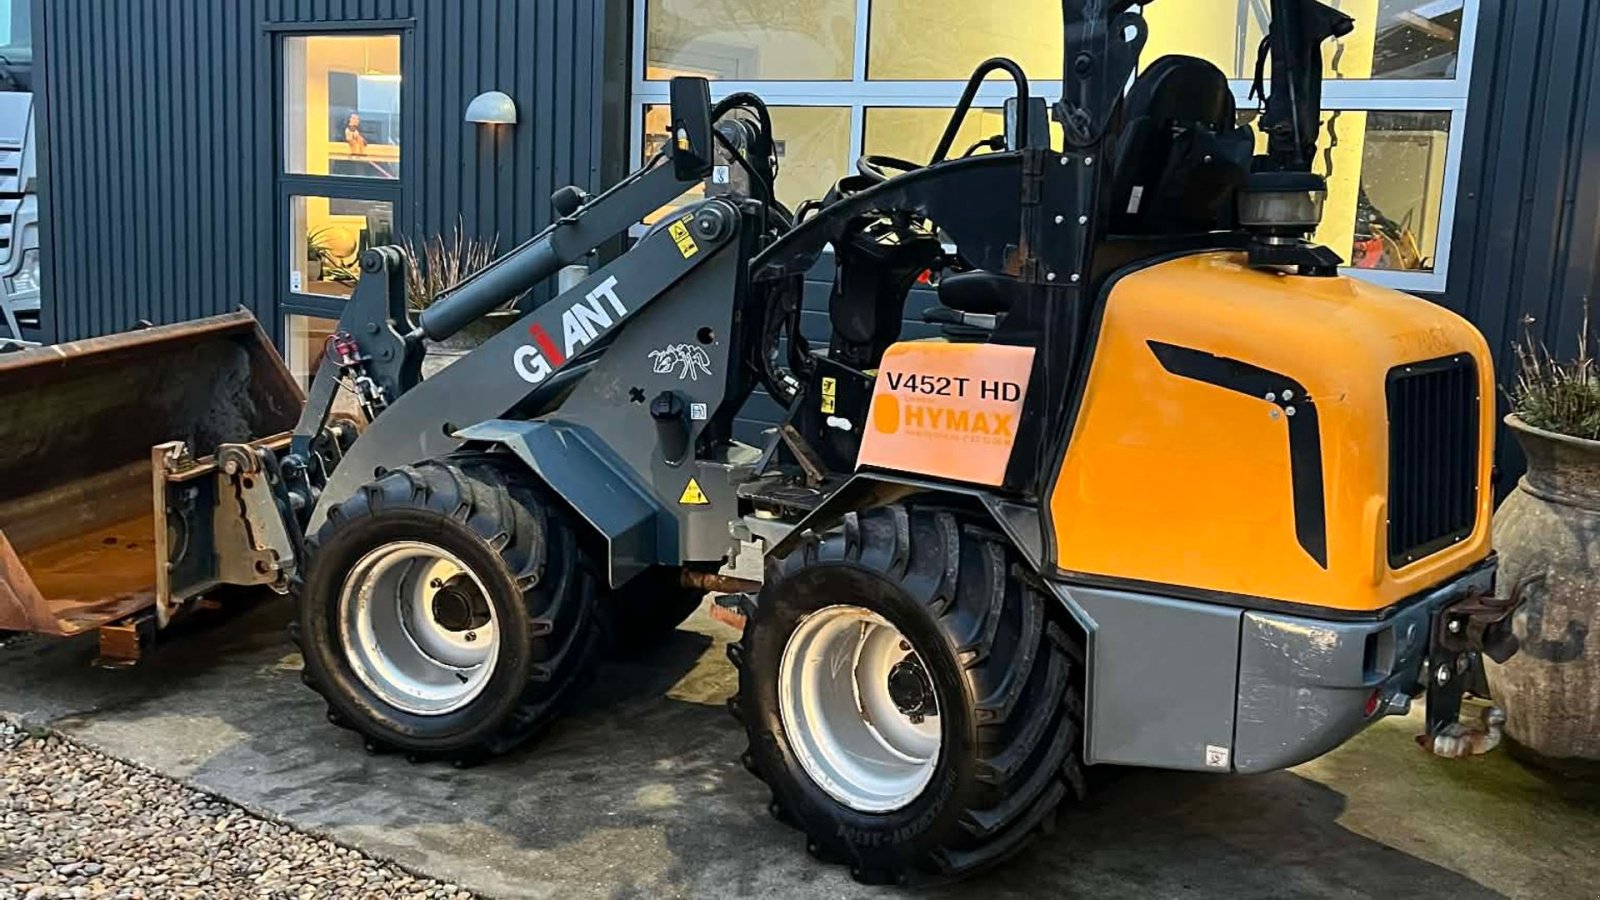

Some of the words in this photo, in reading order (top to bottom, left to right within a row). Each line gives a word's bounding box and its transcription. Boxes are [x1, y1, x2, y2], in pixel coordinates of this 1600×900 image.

[886, 372, 970, 397] V452T
[981, 380, 1021, 402] HD
[905, 404, 1013, 437] HYMAX
